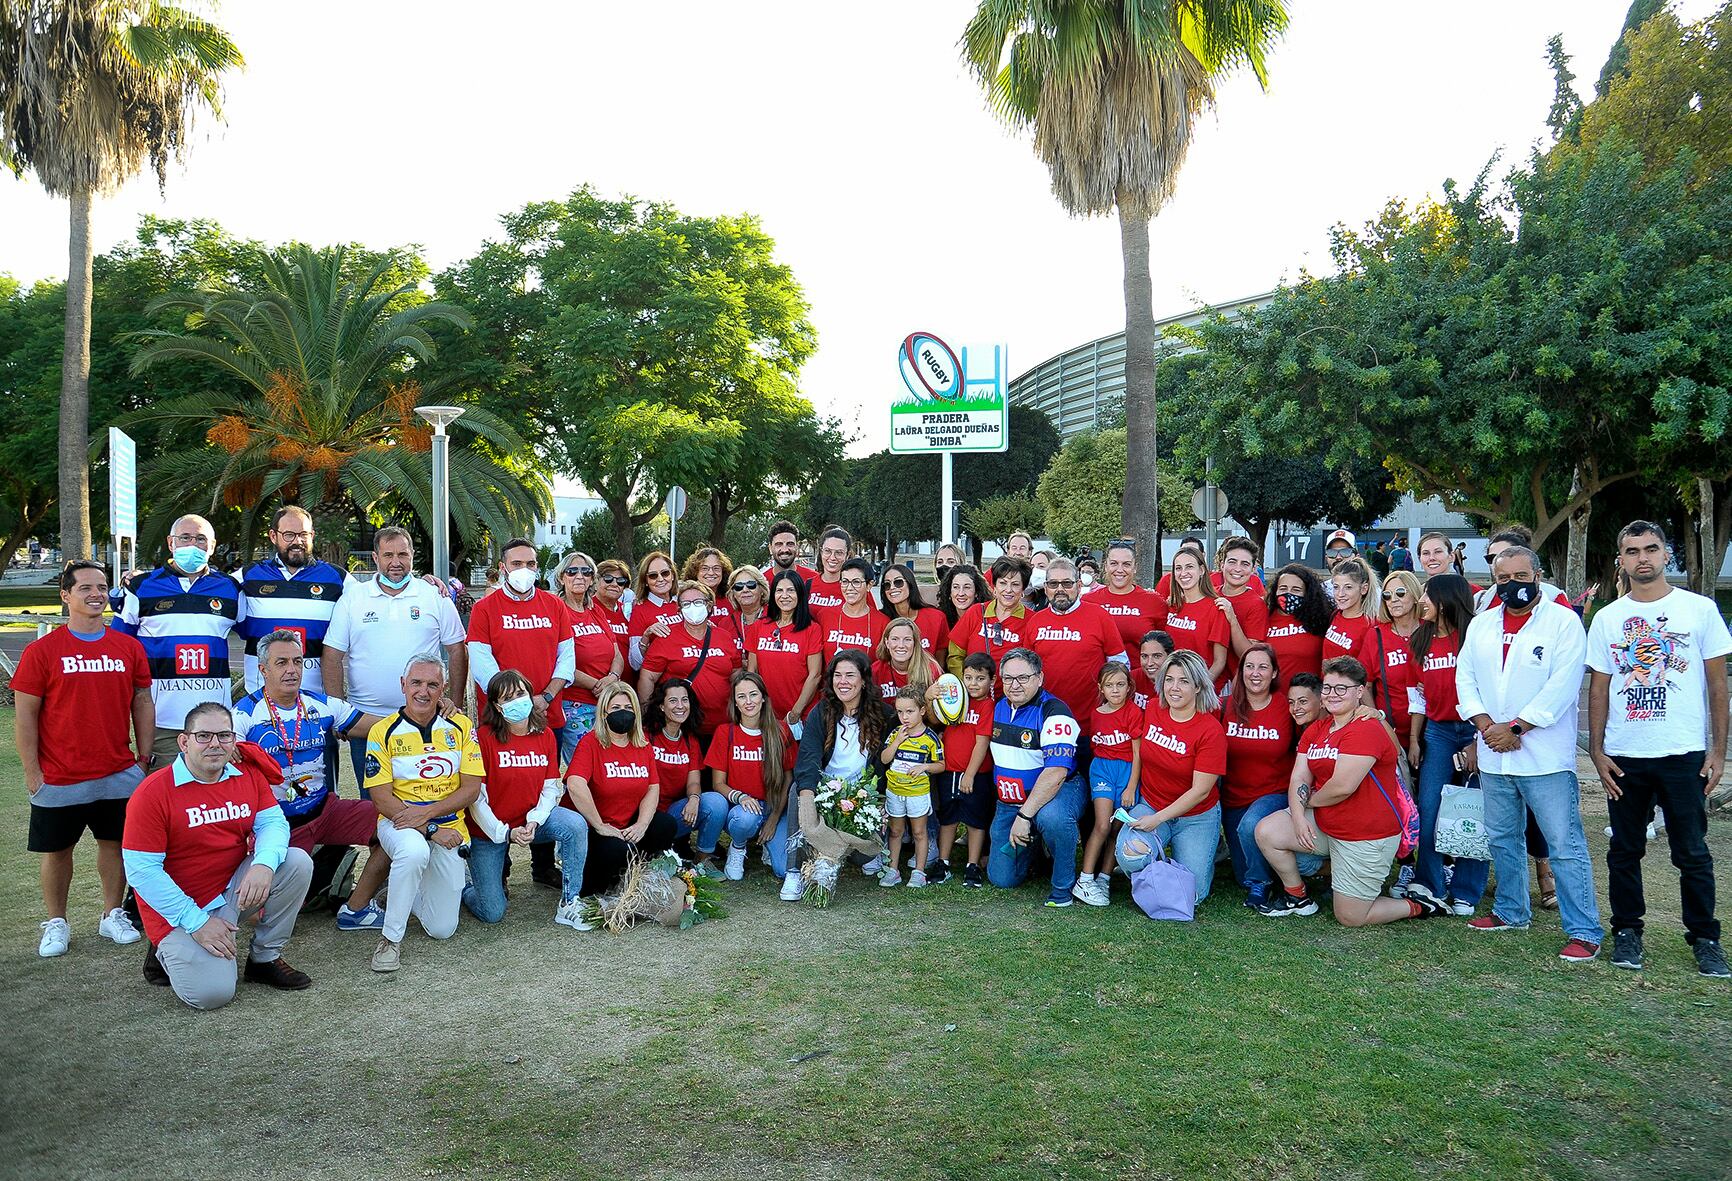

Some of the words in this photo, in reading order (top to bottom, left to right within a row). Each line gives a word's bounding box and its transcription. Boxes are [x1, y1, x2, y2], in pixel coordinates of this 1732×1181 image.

[922, 349, 950, 385] RUGBY
[922, 413, 970, 424] PRADERA
[925, 425, 963, 435] DELGADO
[965, 422, 1000, 433] DUEÑAS
[924, 434, 967, 447] "BIMBA"
[1285, 536, 1311, 560] 17
[502, 613, 552, 630] Bimba
[827, 629, 873, 648] Bimba
[1035, 625, 1082, 642] Bimba
[60, 653, 126, 675] Bimba
[159, 678, 223, 692] MANSION
[1627, 686, 1667, 701] SUPER
[1046, 723, 1072, 736] +50
[1225, 721, 1280, 740] Bimba
[1144, 723, 1187, 755] Bimba
[498, 749, 549, 768] Bimba
[604, 761, 649, 779] Bimba
[186, 800, 252, 828] Bimba
